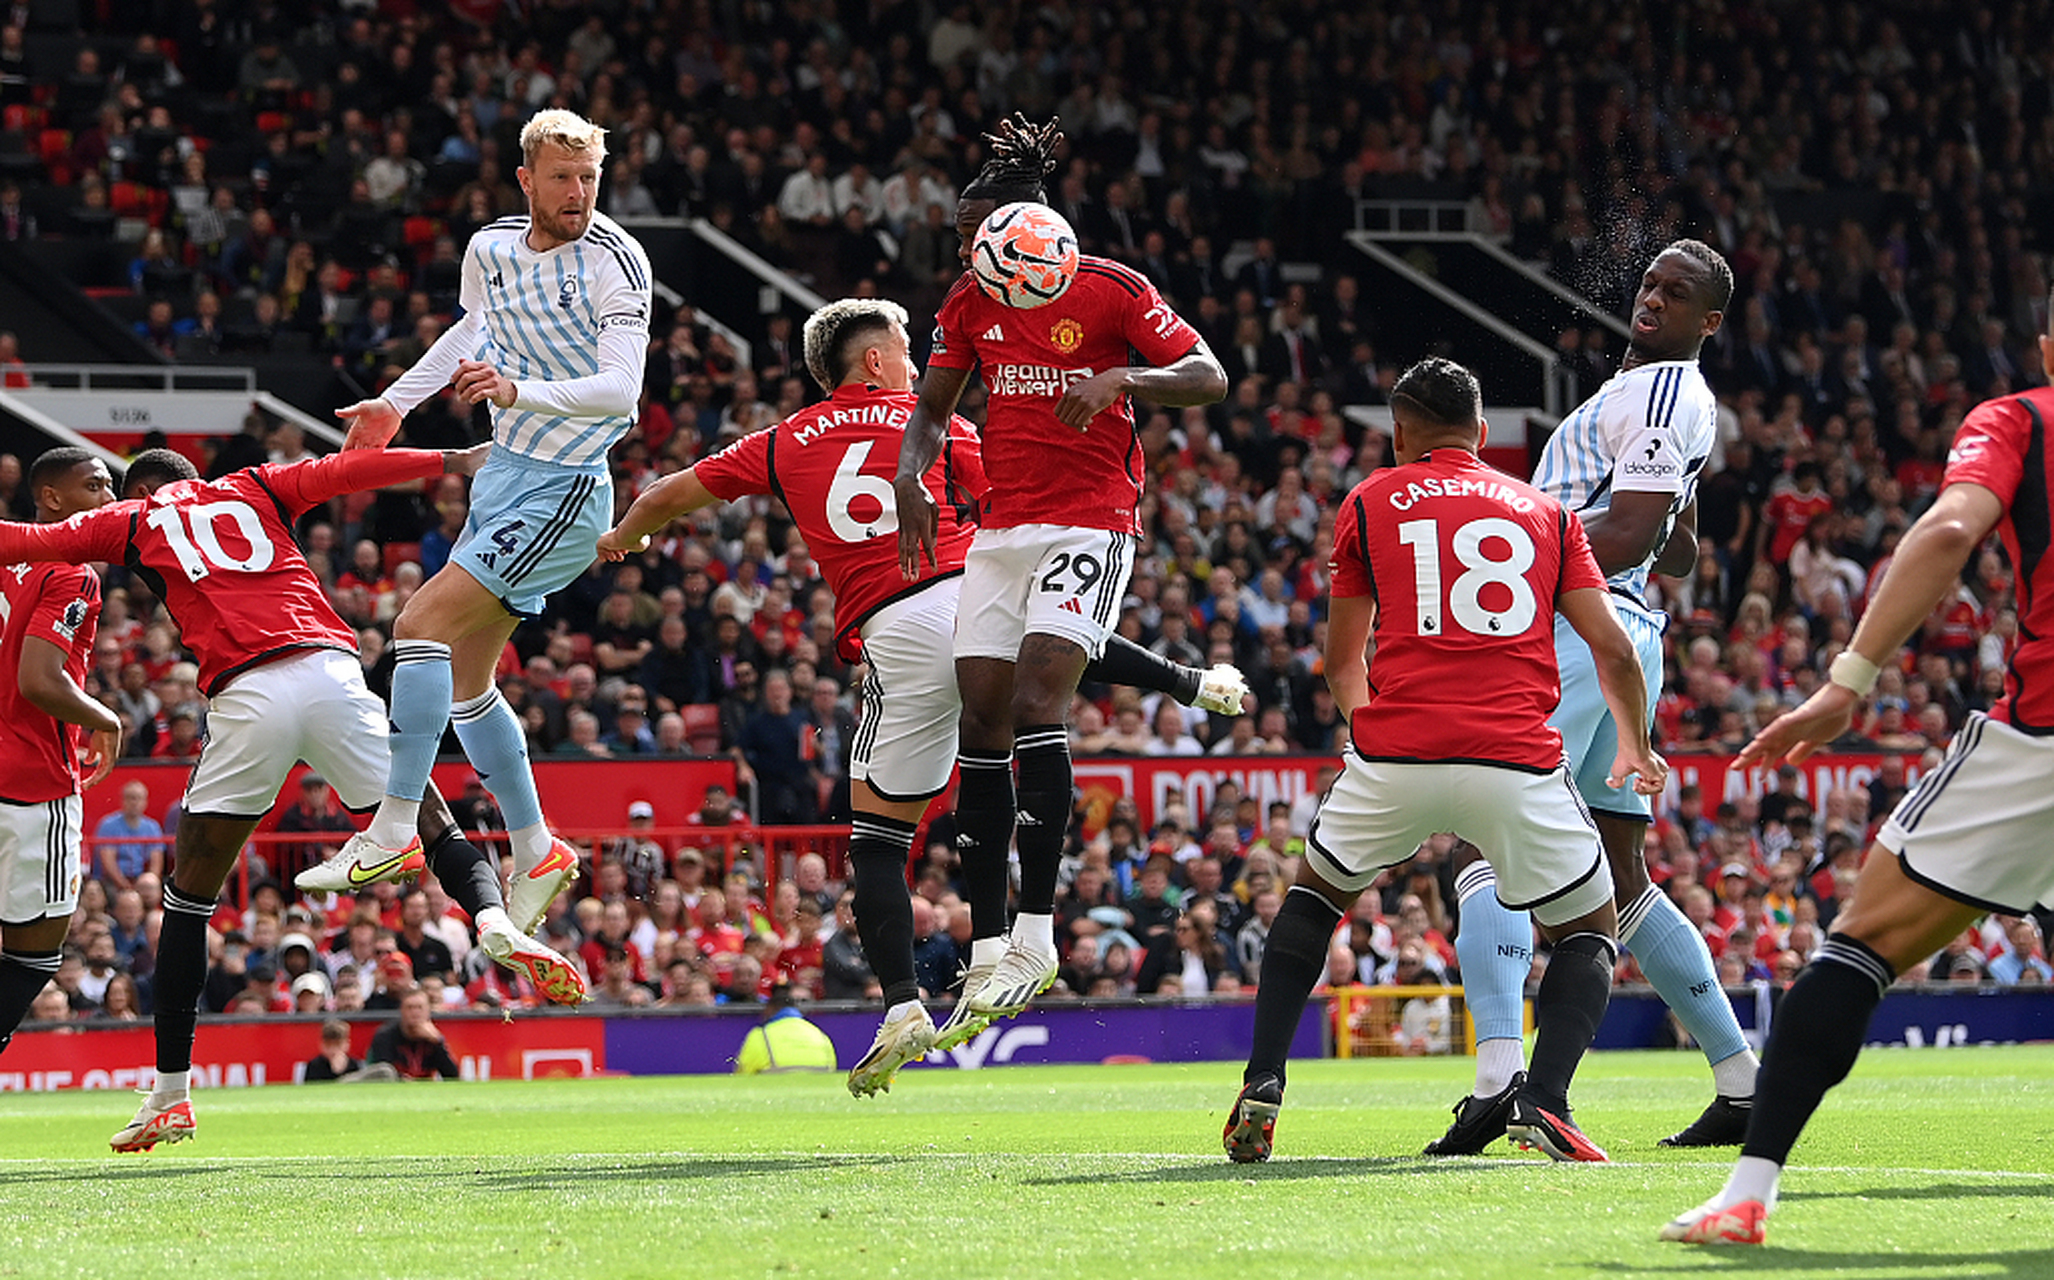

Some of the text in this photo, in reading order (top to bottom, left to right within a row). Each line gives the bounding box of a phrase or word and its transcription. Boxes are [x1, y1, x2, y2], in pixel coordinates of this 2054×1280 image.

[826, 439, 900, 543] 6
[1389, 478, 1536, 513] CASEMIRO
[146, 501, 275, 583] 10
[491, 519, 527, 556] 4
[1040, 553, 1102, 596] 29
[1398, 517, 1537, 637] 18
